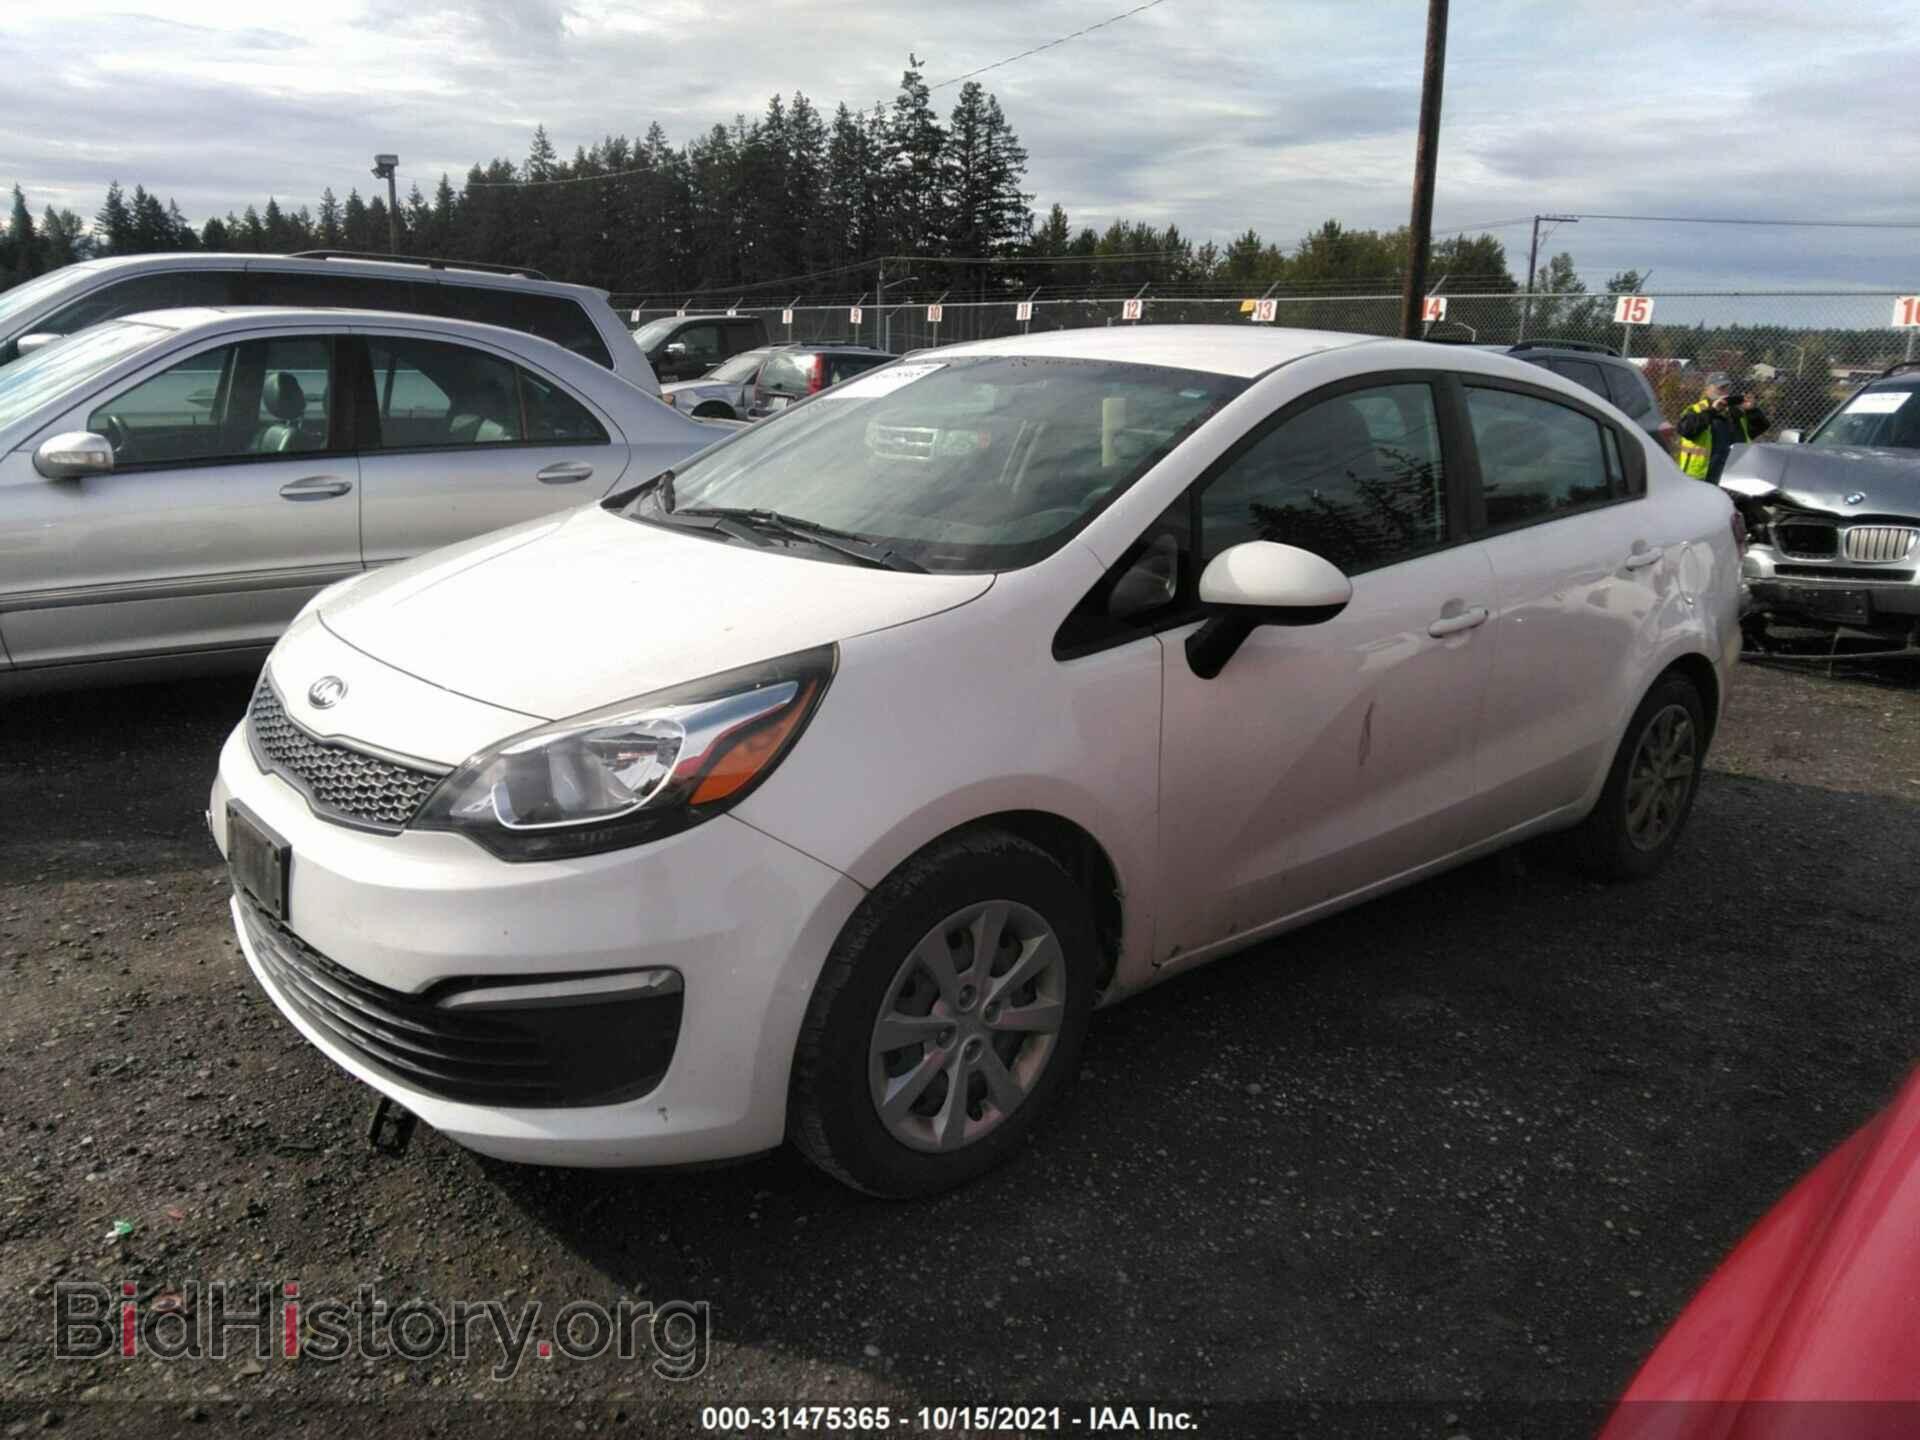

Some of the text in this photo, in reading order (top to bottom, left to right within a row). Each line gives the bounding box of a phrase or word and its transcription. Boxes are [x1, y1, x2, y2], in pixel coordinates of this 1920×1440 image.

[1126, 300, 1137, 319] 12
[1258, 300, 1273, 320] 13
[1622, 298, 1648, 321] 15
